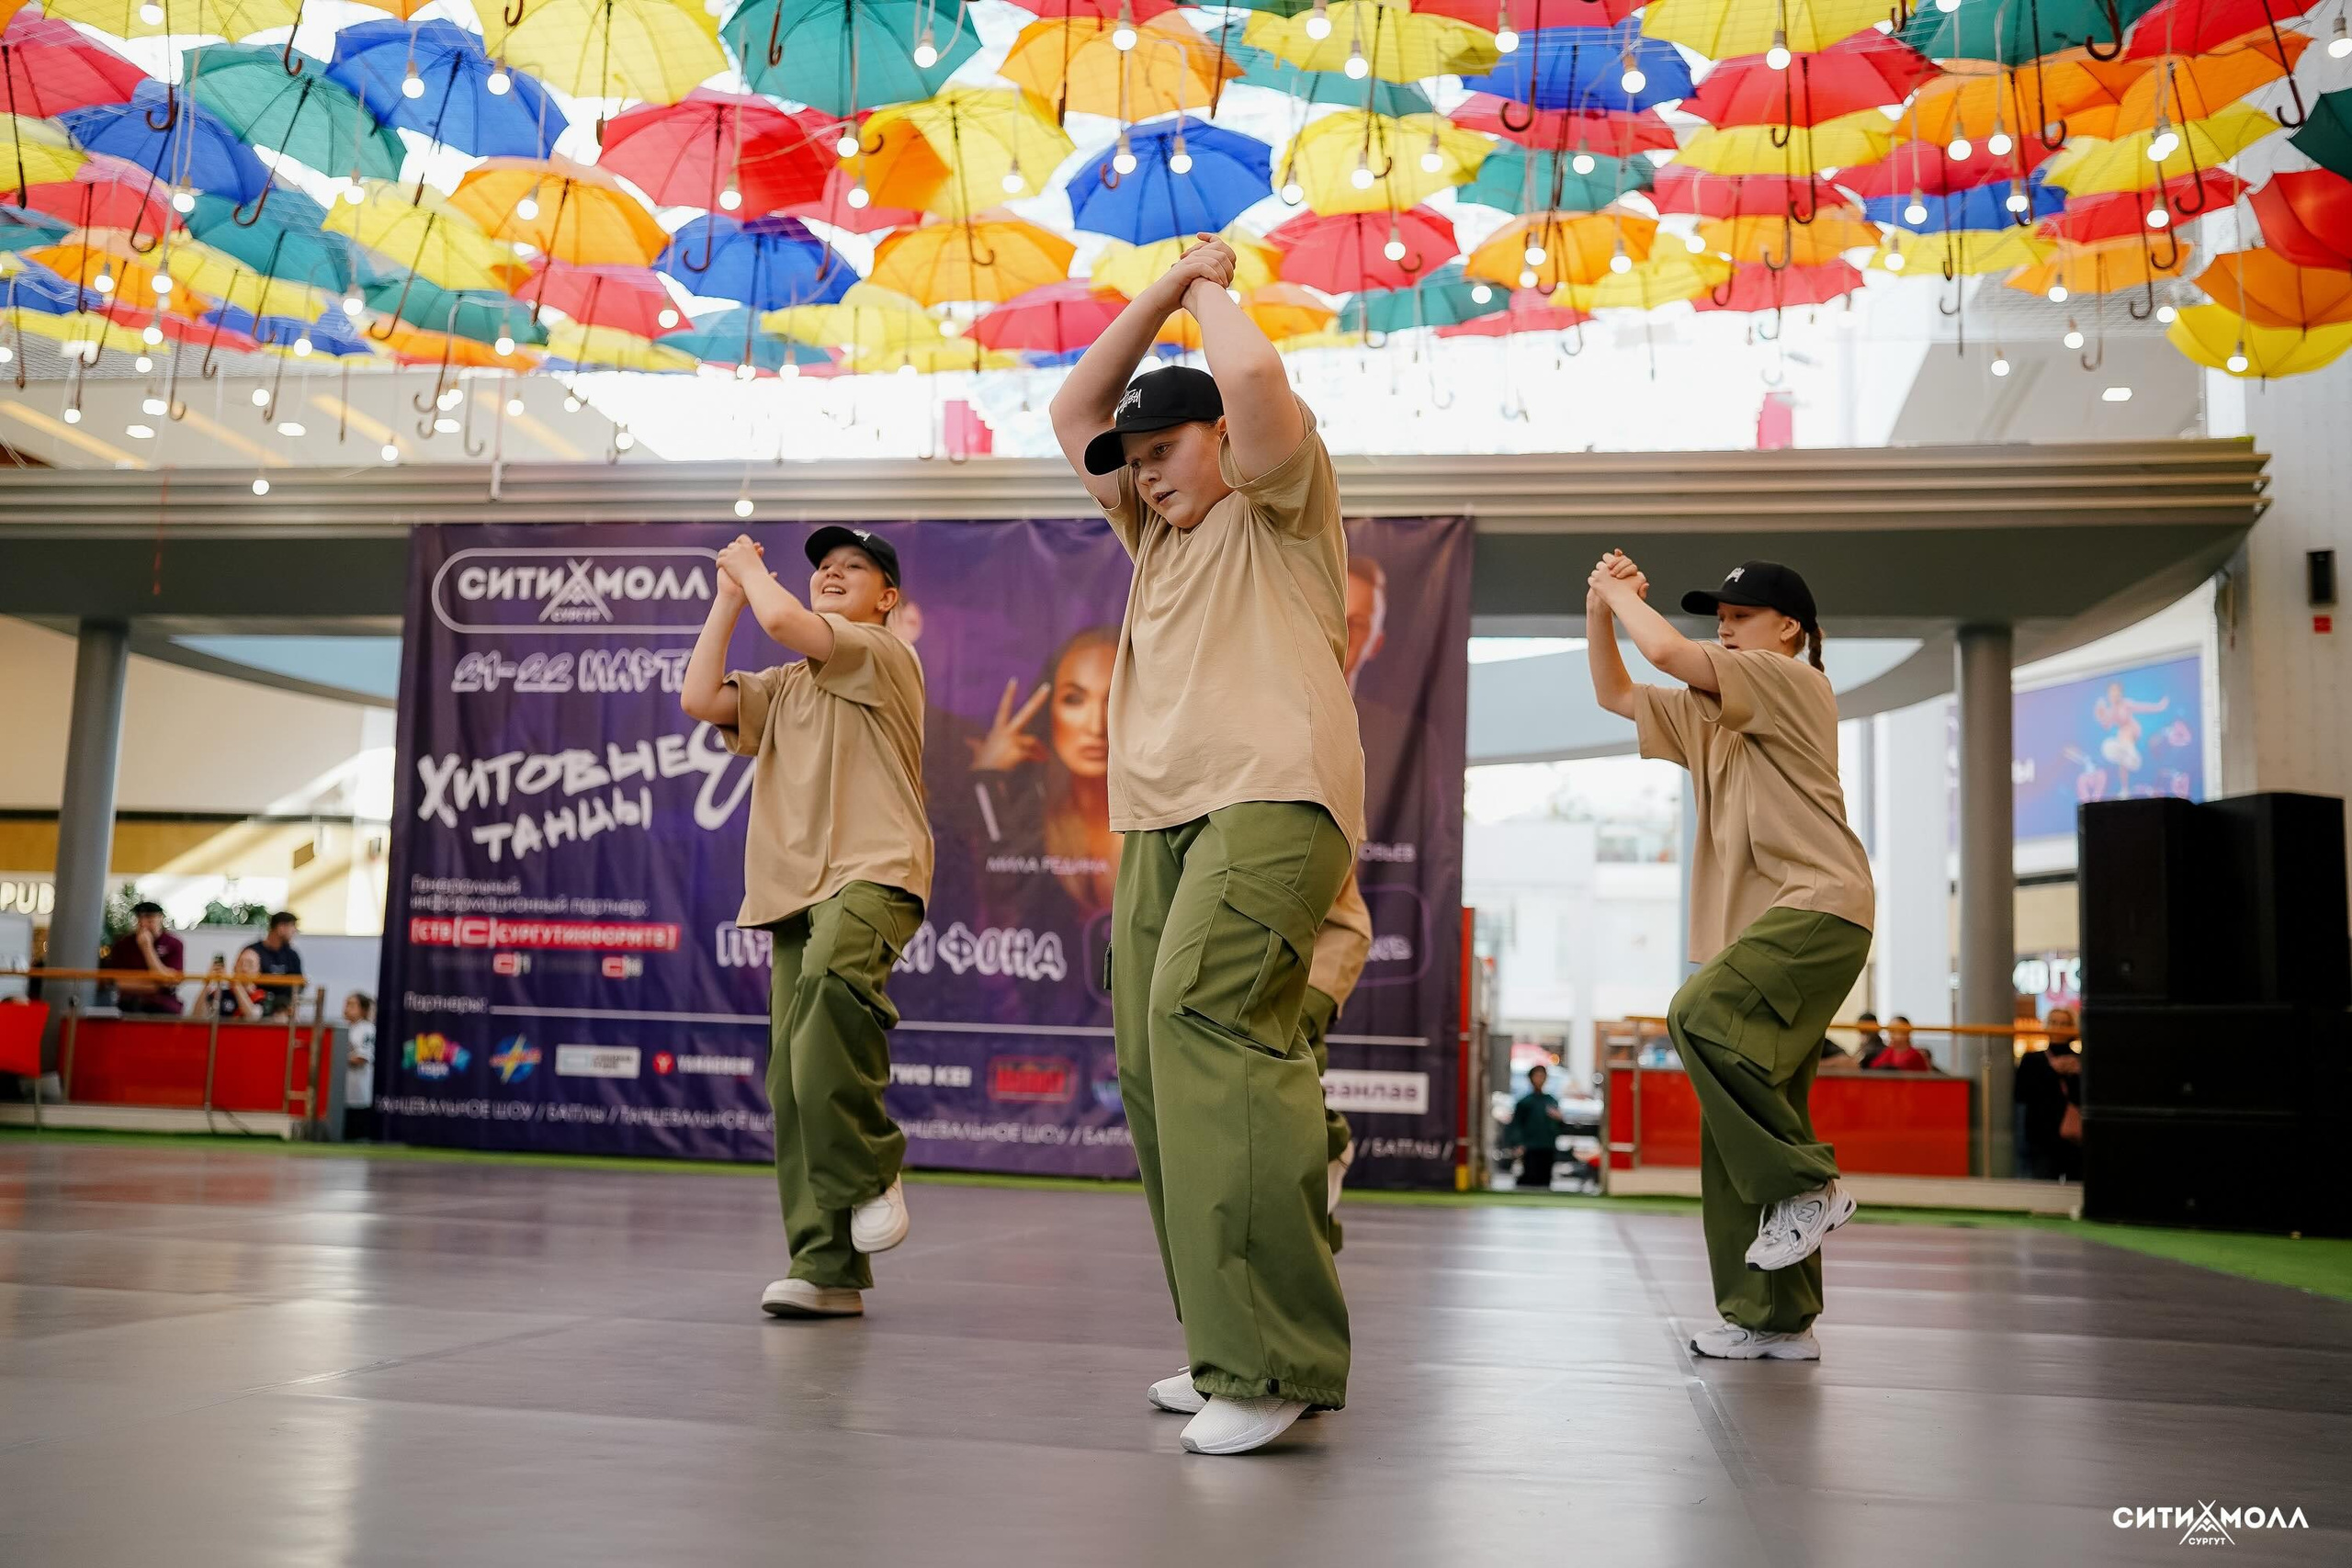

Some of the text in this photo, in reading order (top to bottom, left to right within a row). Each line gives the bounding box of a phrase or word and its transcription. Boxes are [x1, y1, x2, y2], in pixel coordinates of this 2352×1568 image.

[549, 606, 601, 623] СУРГУТ
[451, 647, 695, 694] 21-22 МАРТ
[417, 734, 689, 829] ХИТОВЫЕ
[471, 786, 653, 863] ТАНЦЫ
